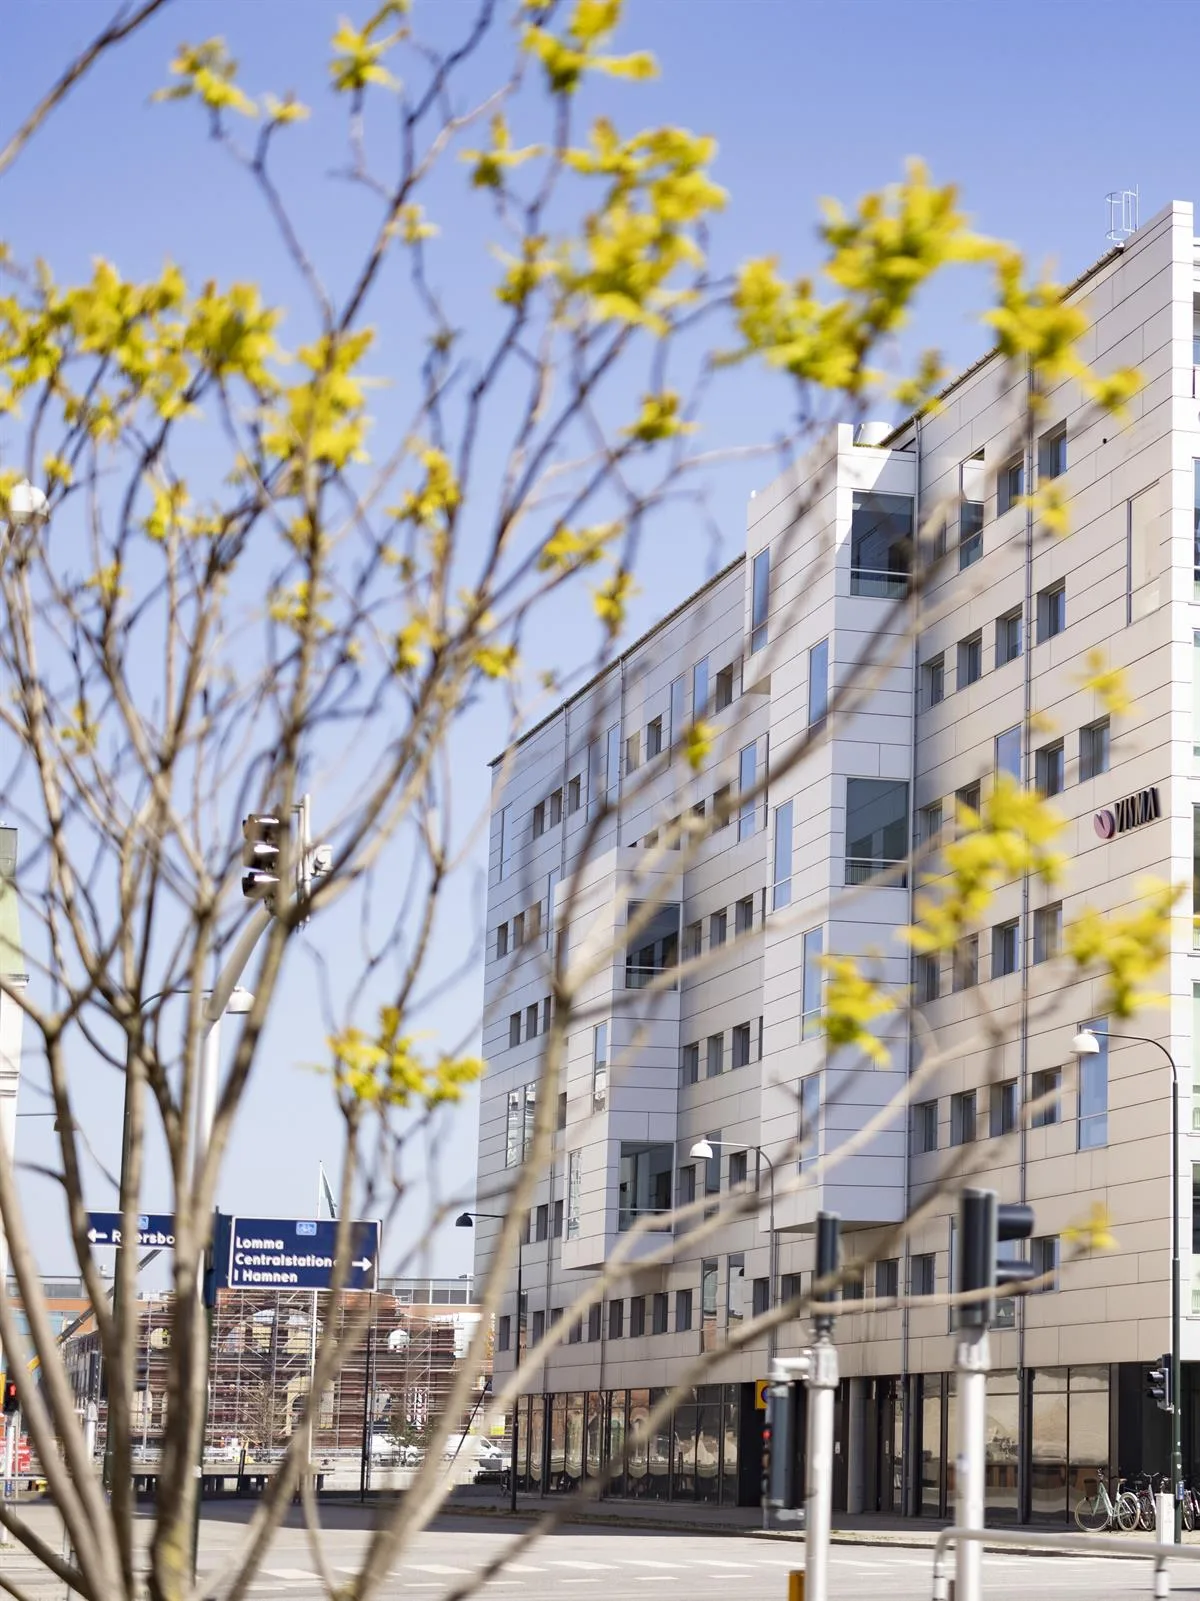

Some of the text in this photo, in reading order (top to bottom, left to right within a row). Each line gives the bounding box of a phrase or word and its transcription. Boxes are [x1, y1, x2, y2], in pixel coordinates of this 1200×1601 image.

[1114, 786, 1161, 833] VISMA
[236, 1235, 284, 1250] Lomma
[243, 1268, 298, 1283] Hamnen
